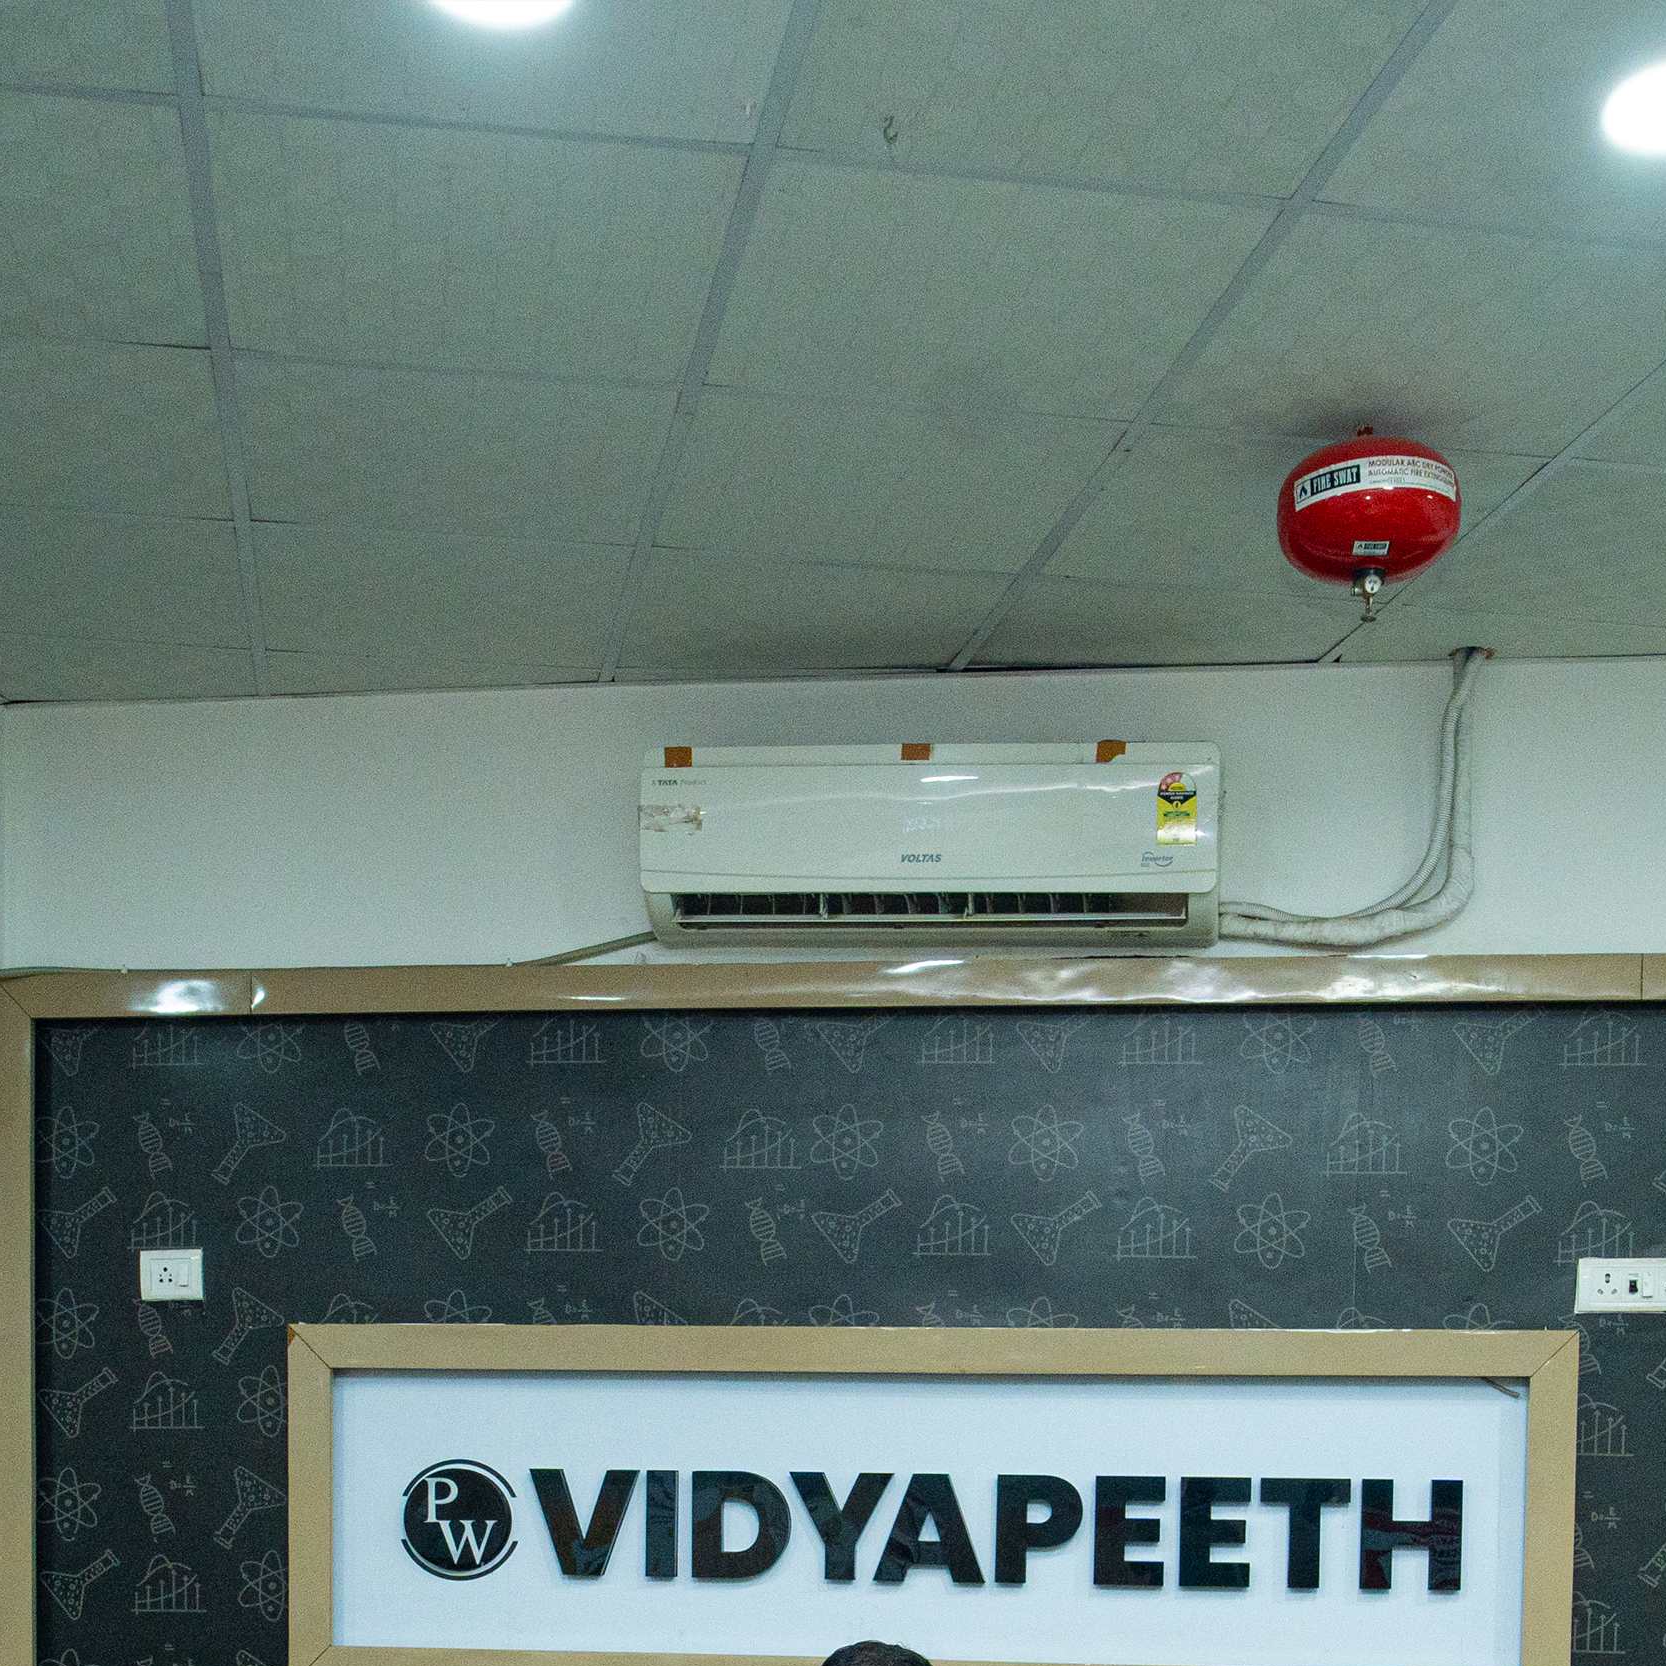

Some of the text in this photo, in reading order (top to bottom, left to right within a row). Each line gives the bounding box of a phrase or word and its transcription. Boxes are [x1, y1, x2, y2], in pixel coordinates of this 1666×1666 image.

[1312, 467, 1359, 492] FIRE SWAT
[901, 854, 942, 863] VOLTAS
[529, 1468, 1464, 1593] VIDYAPEETH
